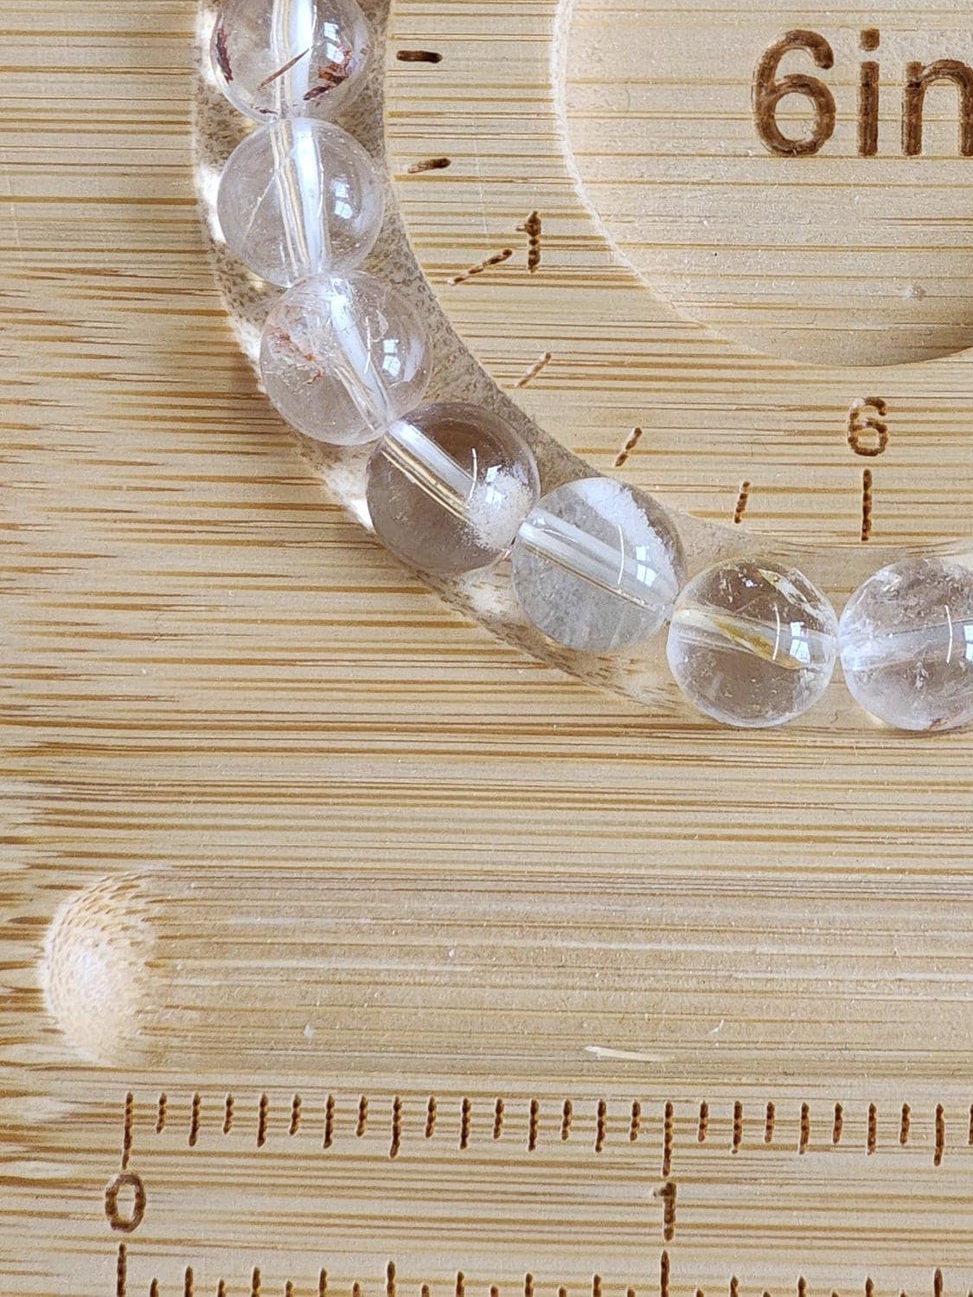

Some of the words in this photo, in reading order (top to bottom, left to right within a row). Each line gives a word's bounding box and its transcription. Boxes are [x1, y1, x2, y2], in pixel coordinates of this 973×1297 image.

[516, 211, 542, 273] 1
[847, 397, 890, 457] 6
[105, 1174, 147, 1233] 0
[652, 1182, 677, 1241] 1
